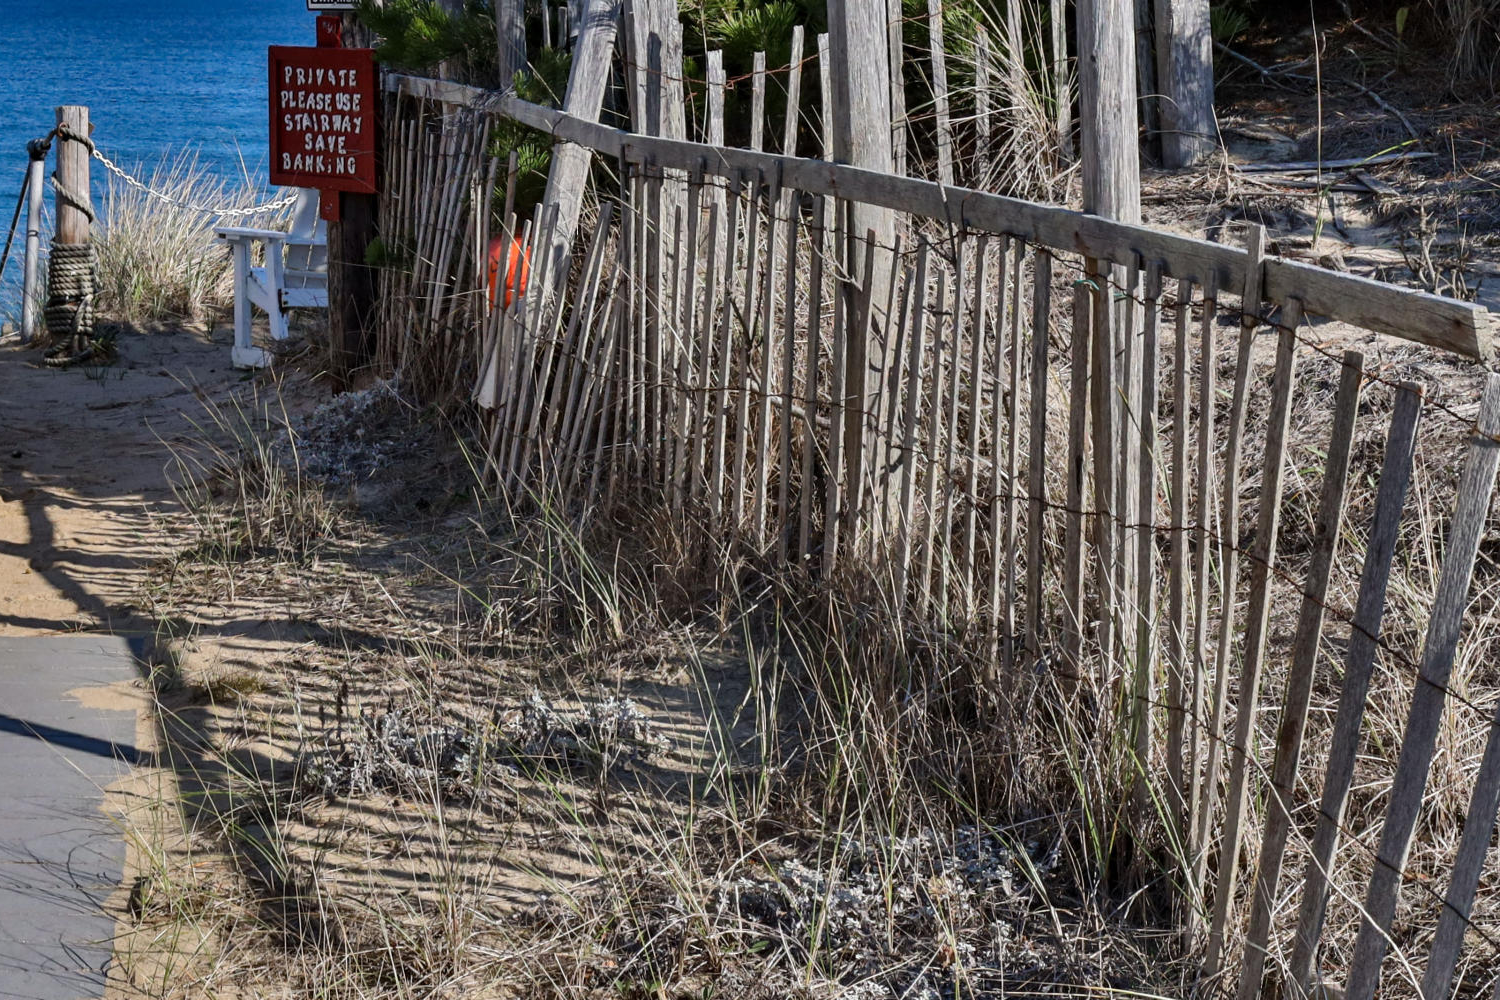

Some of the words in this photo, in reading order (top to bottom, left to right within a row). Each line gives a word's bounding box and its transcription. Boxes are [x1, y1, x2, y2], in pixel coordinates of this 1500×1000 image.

[284, 66, 356, 86] PRIVATE
[280, 90, 332, 112] PLEASE
[336, 92, 361, 111] USE
[284, 113, 362, 134] STAIRWAY
[305, 133, 346, 154] SAVE
